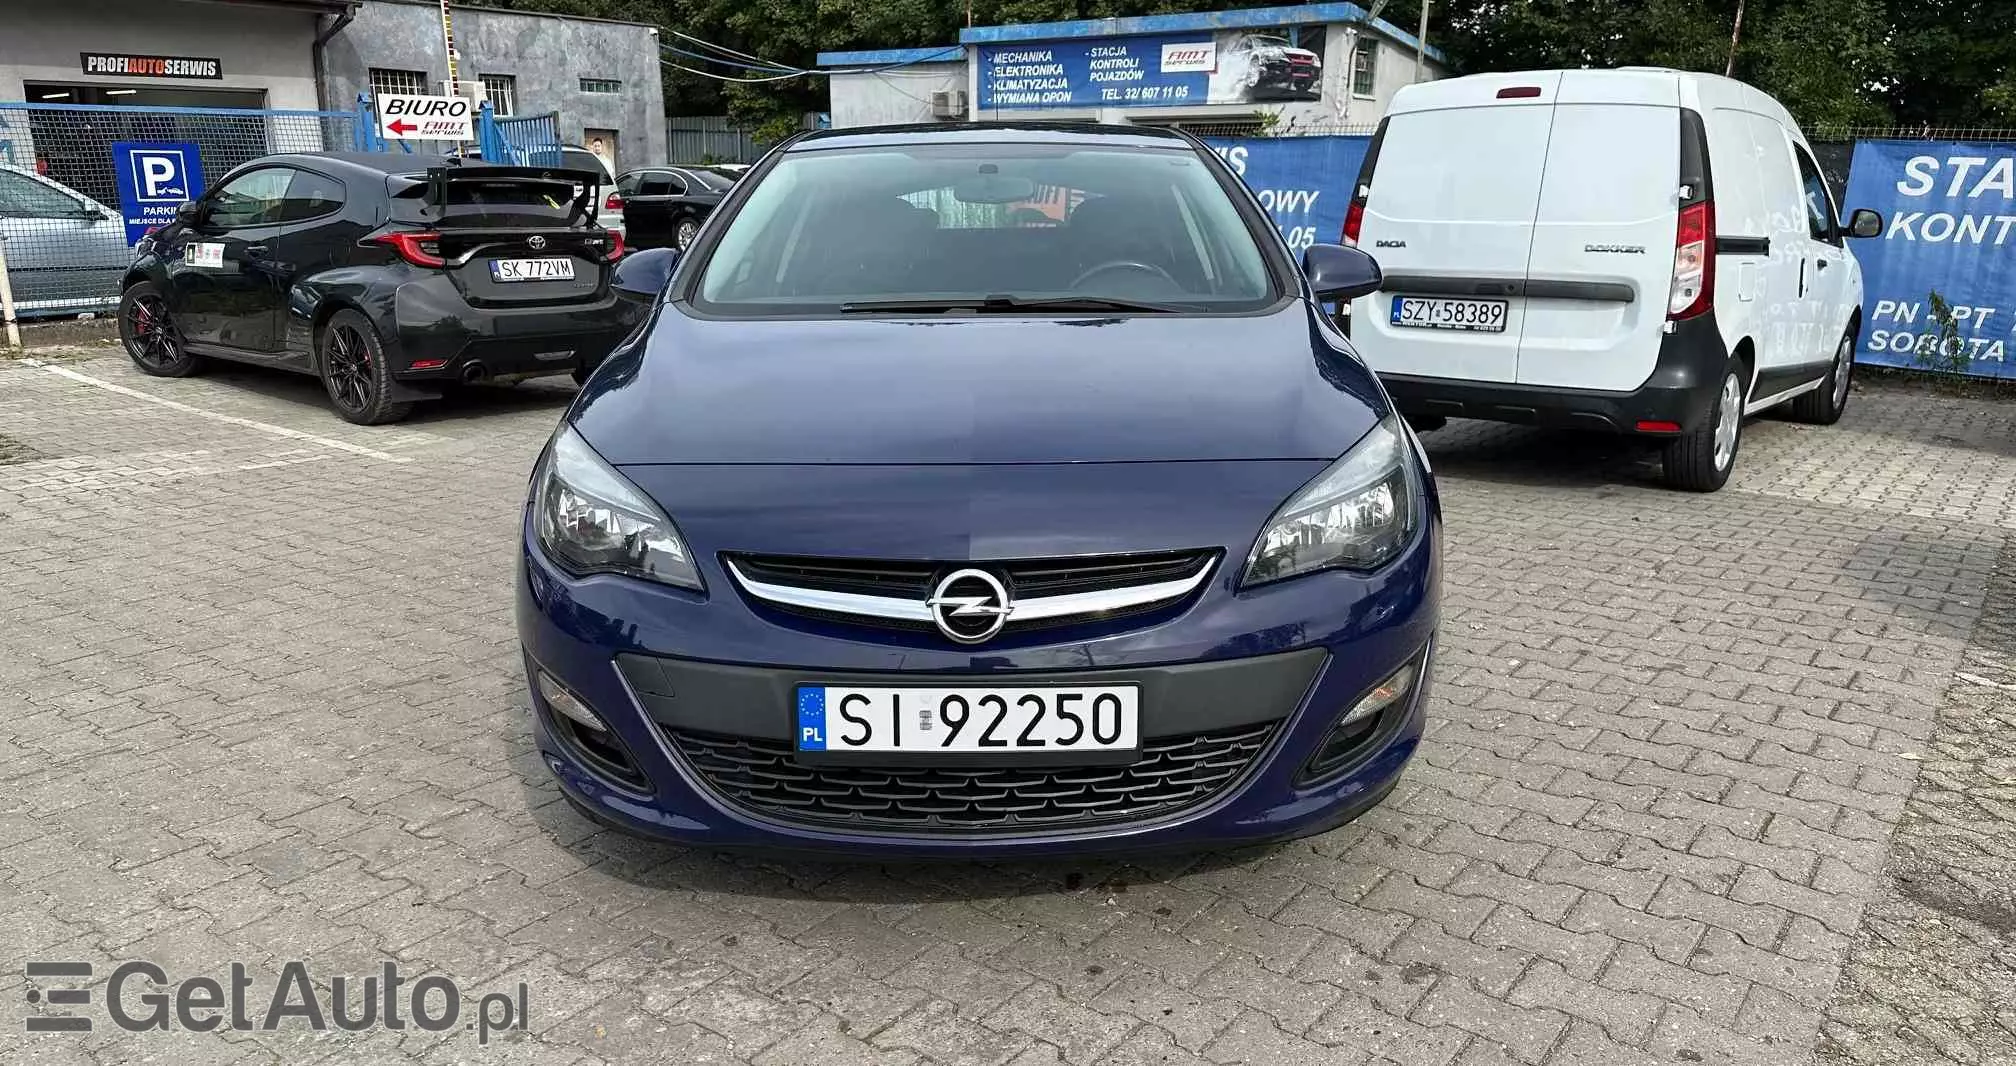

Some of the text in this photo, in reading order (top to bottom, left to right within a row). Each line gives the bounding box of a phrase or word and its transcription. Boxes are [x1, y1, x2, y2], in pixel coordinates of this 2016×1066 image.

[994, 50, 1052, 63] MECHANIKA
[1091, 46, 1127, 57] STACJA
[87, 56, 216, 76] PROFIAUTOSERWIS
[994, 64, 1063, 77] ELEKTRONIKA
[1090, 58, 1139, 69] KONTROLI
[1090, 70, 1144, 82] POJAZDÓW
[994, 77, 1067, 90] KLIMATYZACJA
[994, 92, 1040, 104] WYMIANA
[1042, 91, 1072, 103] OPON
[1102, 86, 1188, 100] TEL. 32/ 607 11 05
[385, 98, 467, 117] BIURO
[1376, 240, 1406, 249] DACIA
[502, 261, 522, 277] SK
[527, 261, 572, 276] 772VM
[1402, 300, 1502, 325] SZY 58389
[1872, 300, 1920, 323] PN
[1950, 305, 1996, 329] PT
[1867, 329, 2005, 362] SOBOTA
[839, 693, 1122, 747] SI 92250
[803, 728, 823, 742] PL
